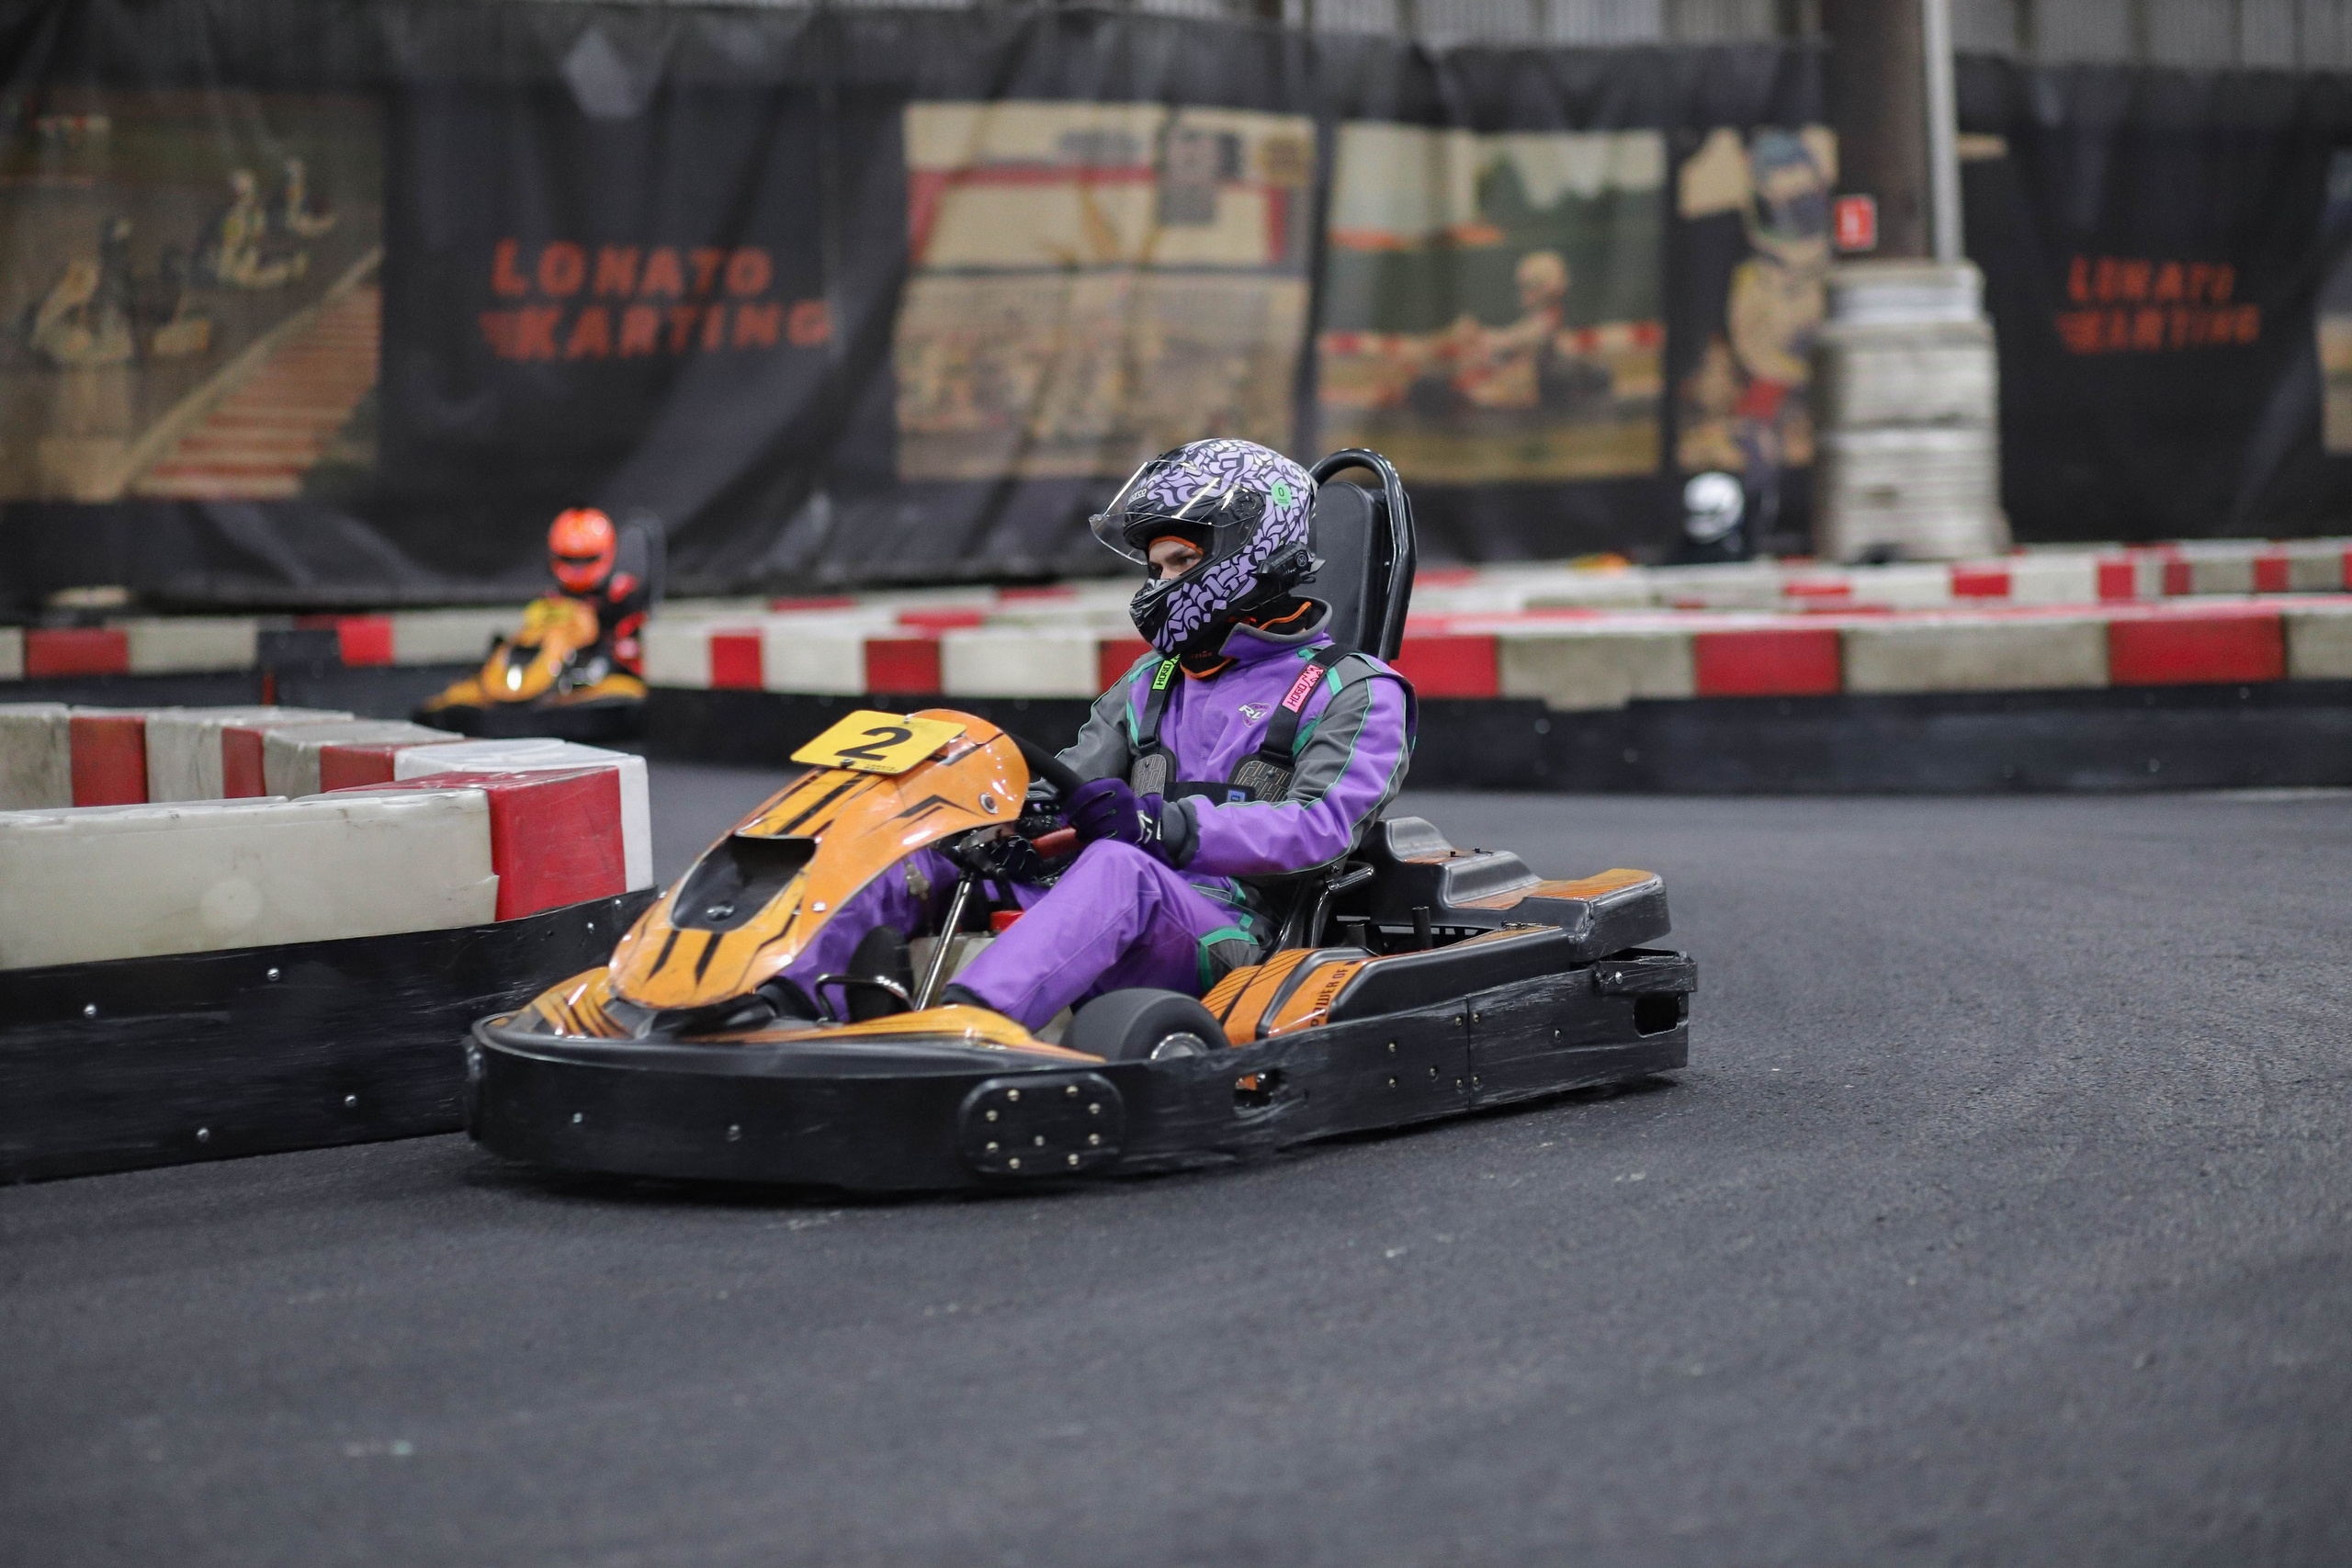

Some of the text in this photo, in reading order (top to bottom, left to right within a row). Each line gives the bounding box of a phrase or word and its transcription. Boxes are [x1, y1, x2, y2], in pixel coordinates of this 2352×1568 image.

[492, 238, 774, 297] LONATO
[481, 299, 833, 360] KARTING
[1286, 682, 1307, 707] HOGO
[834, 727, 913, 761] 2
[1310, 969, 1348, 1026] POWER OF
